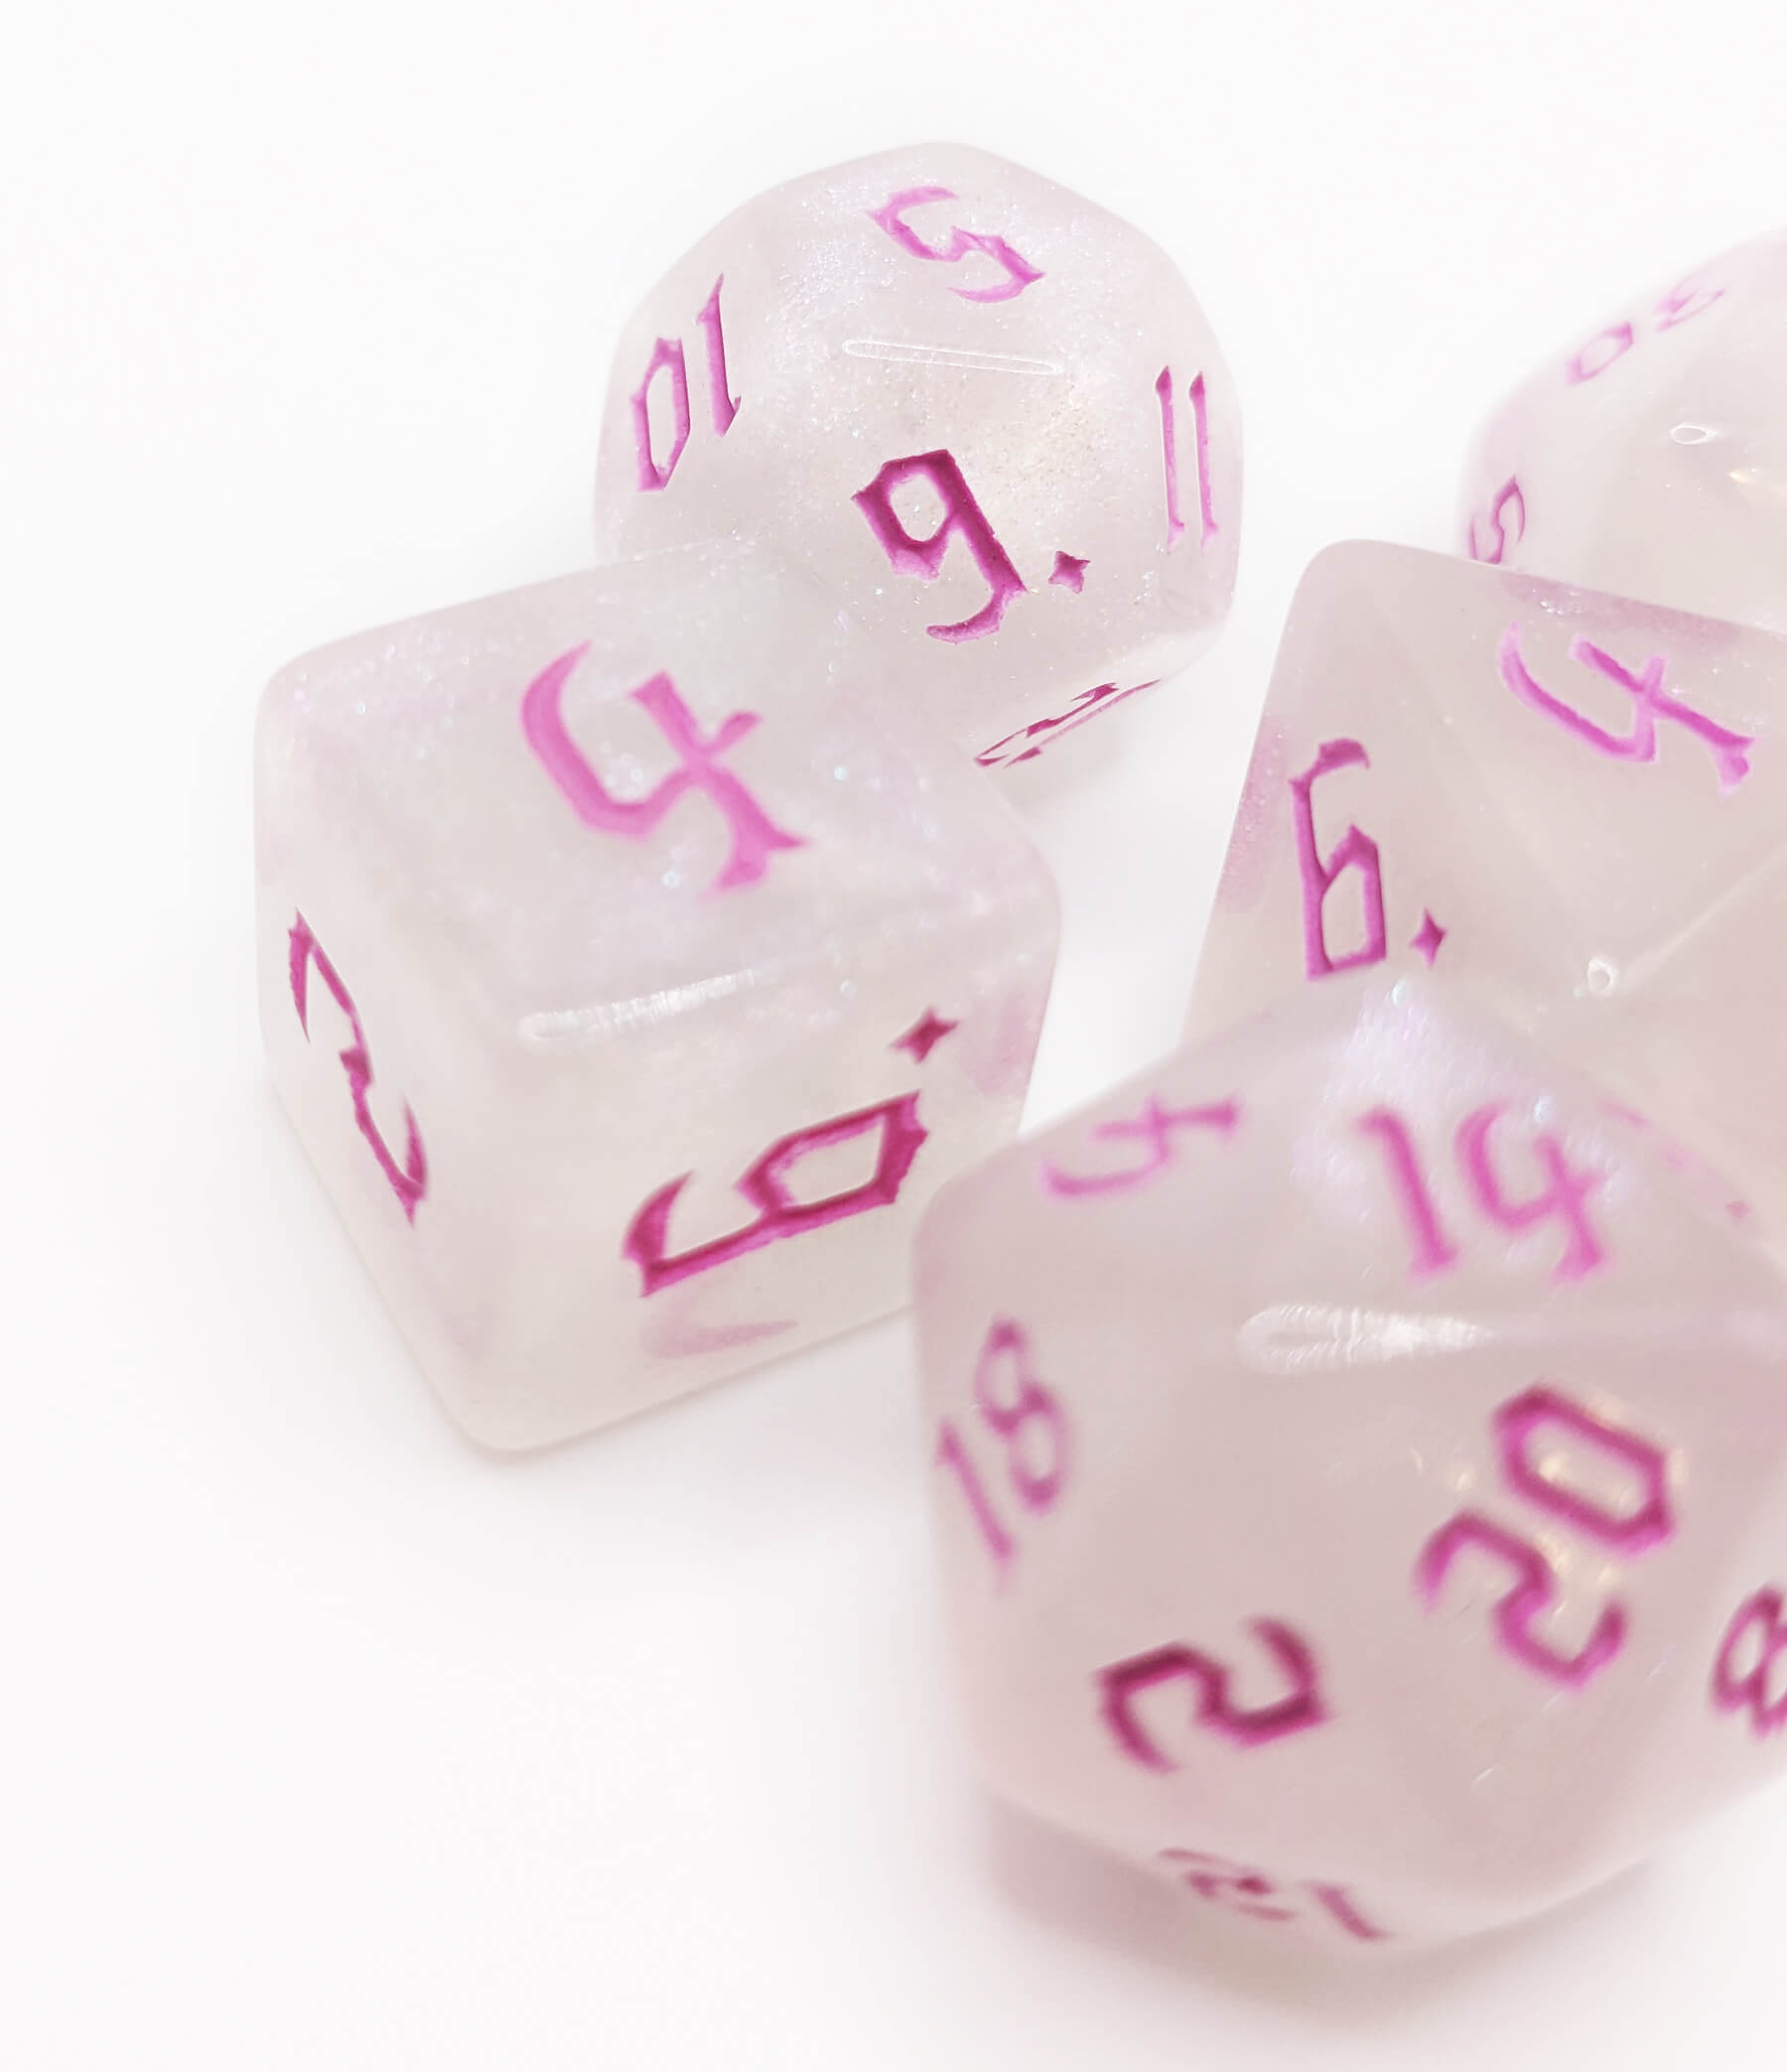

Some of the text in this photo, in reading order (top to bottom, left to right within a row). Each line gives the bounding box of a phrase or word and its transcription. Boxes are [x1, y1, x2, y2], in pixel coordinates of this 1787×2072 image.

[867, 186, 1044, 303] 5
[630, 273, 742, 491] 10
[1155, 364, 1218, 552] 11
[520, 641, 811, 897] 4
[1500, 623, 1757, 794] 4
[288, 907, 427, 1227] 2
[1037, 1094, 1243, 1204] 4
[1357, 1100, 1613, 1285] 14
[935, 1318, 1076, 1589] 18
[1414, 1380, 1678, 1694] 20
[1094, 1614, 1330, 1775] 2
